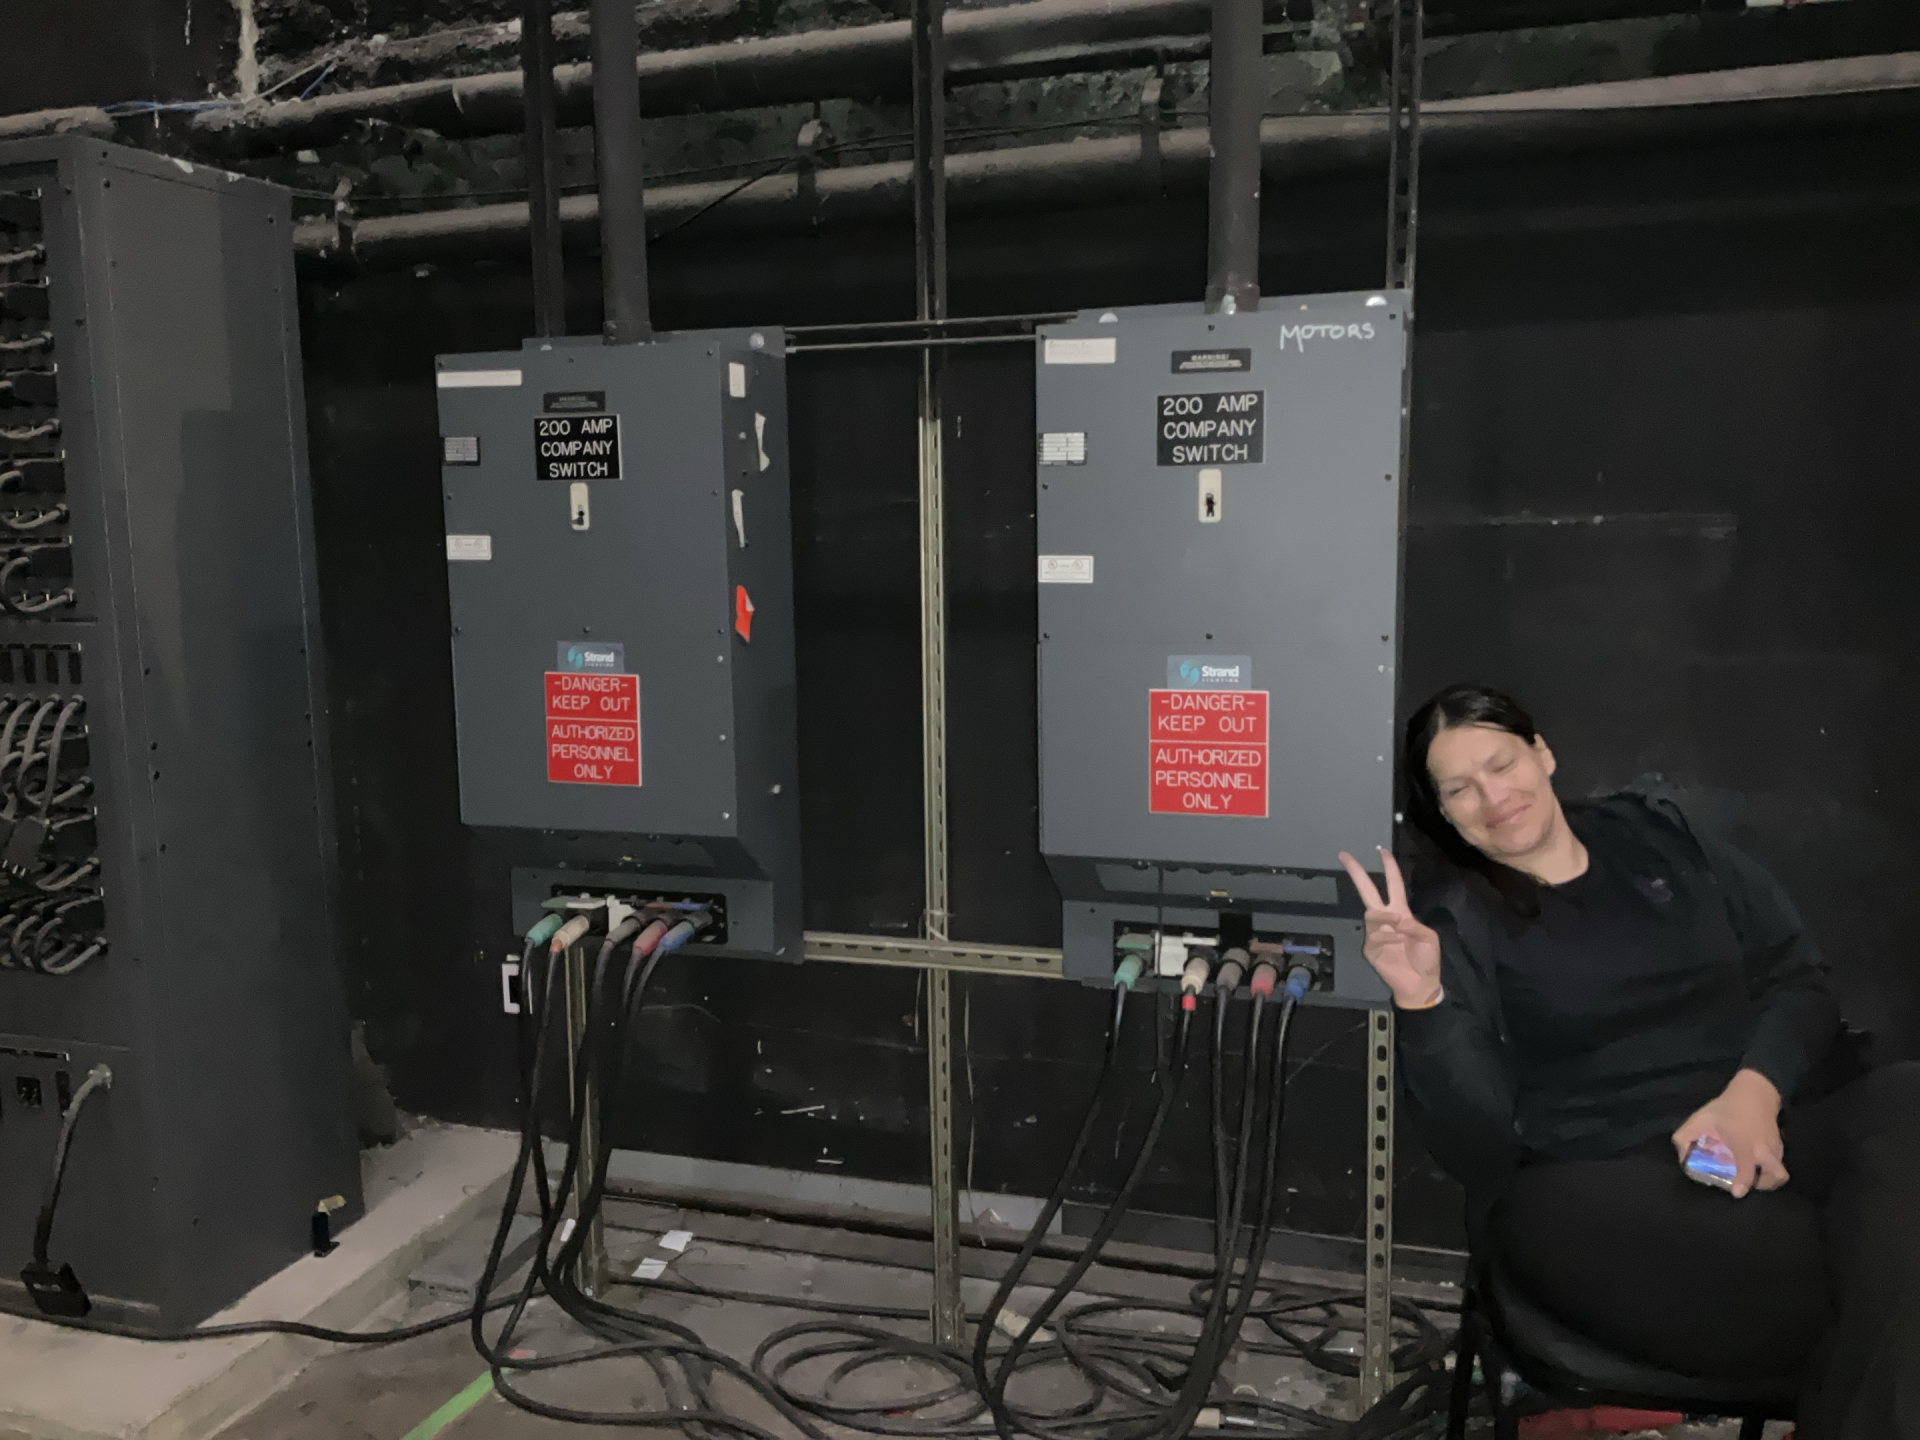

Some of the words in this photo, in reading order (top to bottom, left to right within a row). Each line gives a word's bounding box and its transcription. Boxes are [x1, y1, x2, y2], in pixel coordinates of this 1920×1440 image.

[1279, 322, 1375, 352] MOTORS
[1163, 397, 1203, 416] 200
[1216, 393, 1258, 413] AMP
[539, 420, 571, 436] 200
[581, 418, 613, 434] AMP
[1163, 419, 1257, 439] COMPANY
[541, 440, 613, 457] COMPANY
[1172, 444, 1248, 463] SWITCH
[549, 461, 608, 478] SWITCH
[584, 651, 615, 663] Strand
[1201, 665, 1239, 677] Strand
[552, 695, 590, 710] KEEP
[600, 696, 630, 711] OUT
[551, 724, 635, 741] AUTHORIZED
[1158, 715, 1206, 732] KEEP
[1219, 716, 1257, 733] OUT
[552, 744, 635, 762] PERSONNEL
[1155, 747, 1262, 767] AUTHORIZED
[573, 763, 613, 779] ONLY
[1155, 770, 1260, 790] PERSONNEL
[1182, 792, 1233, 809] ONLY
